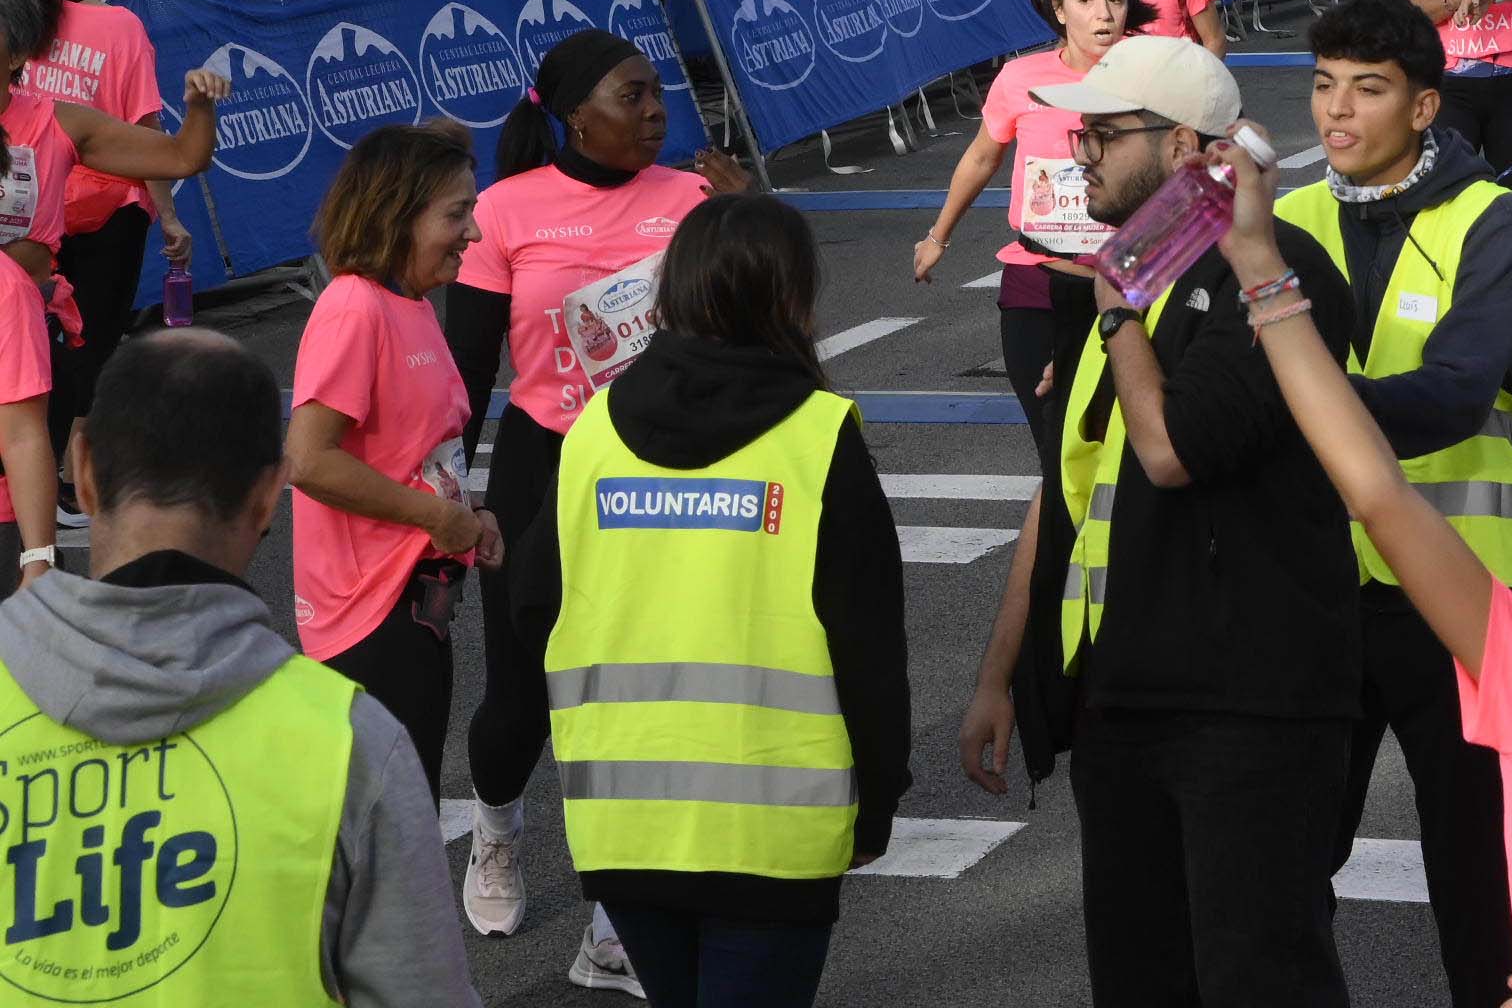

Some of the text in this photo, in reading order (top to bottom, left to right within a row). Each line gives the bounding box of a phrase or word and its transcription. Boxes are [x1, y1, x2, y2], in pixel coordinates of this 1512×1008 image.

[439, 40, 506, 61] CENTRAL LECHERA
[1447, 36, 1500, 55] SUMA
[36, 64, 99, 102] CHICAS!
[328, 59, 401, 85] CENTRAL LECHERA
[429, 52, 521, 102] ASTURIANA
[255, 81, 292, 100] LECHERA
[317, 76, 417, 127] ASTURIANA
[535, 224, 593, 240] OYSHO
[1034, 224, 1063, 232] CARRERA
[601, 281, 650, 311] ASTURIANA
[600, 491, 758, 519] VOLUNTARIS
[768, 484, 780, 533] 2000
[5, 810, 218, 952] Life
[31, 953, 62, 977] vida
[61, 966, 79, 981] es
[80, 966, 94, 981] el
[96, 958, 135, 982] mejor
[135, 931, 181, 968] deporte
